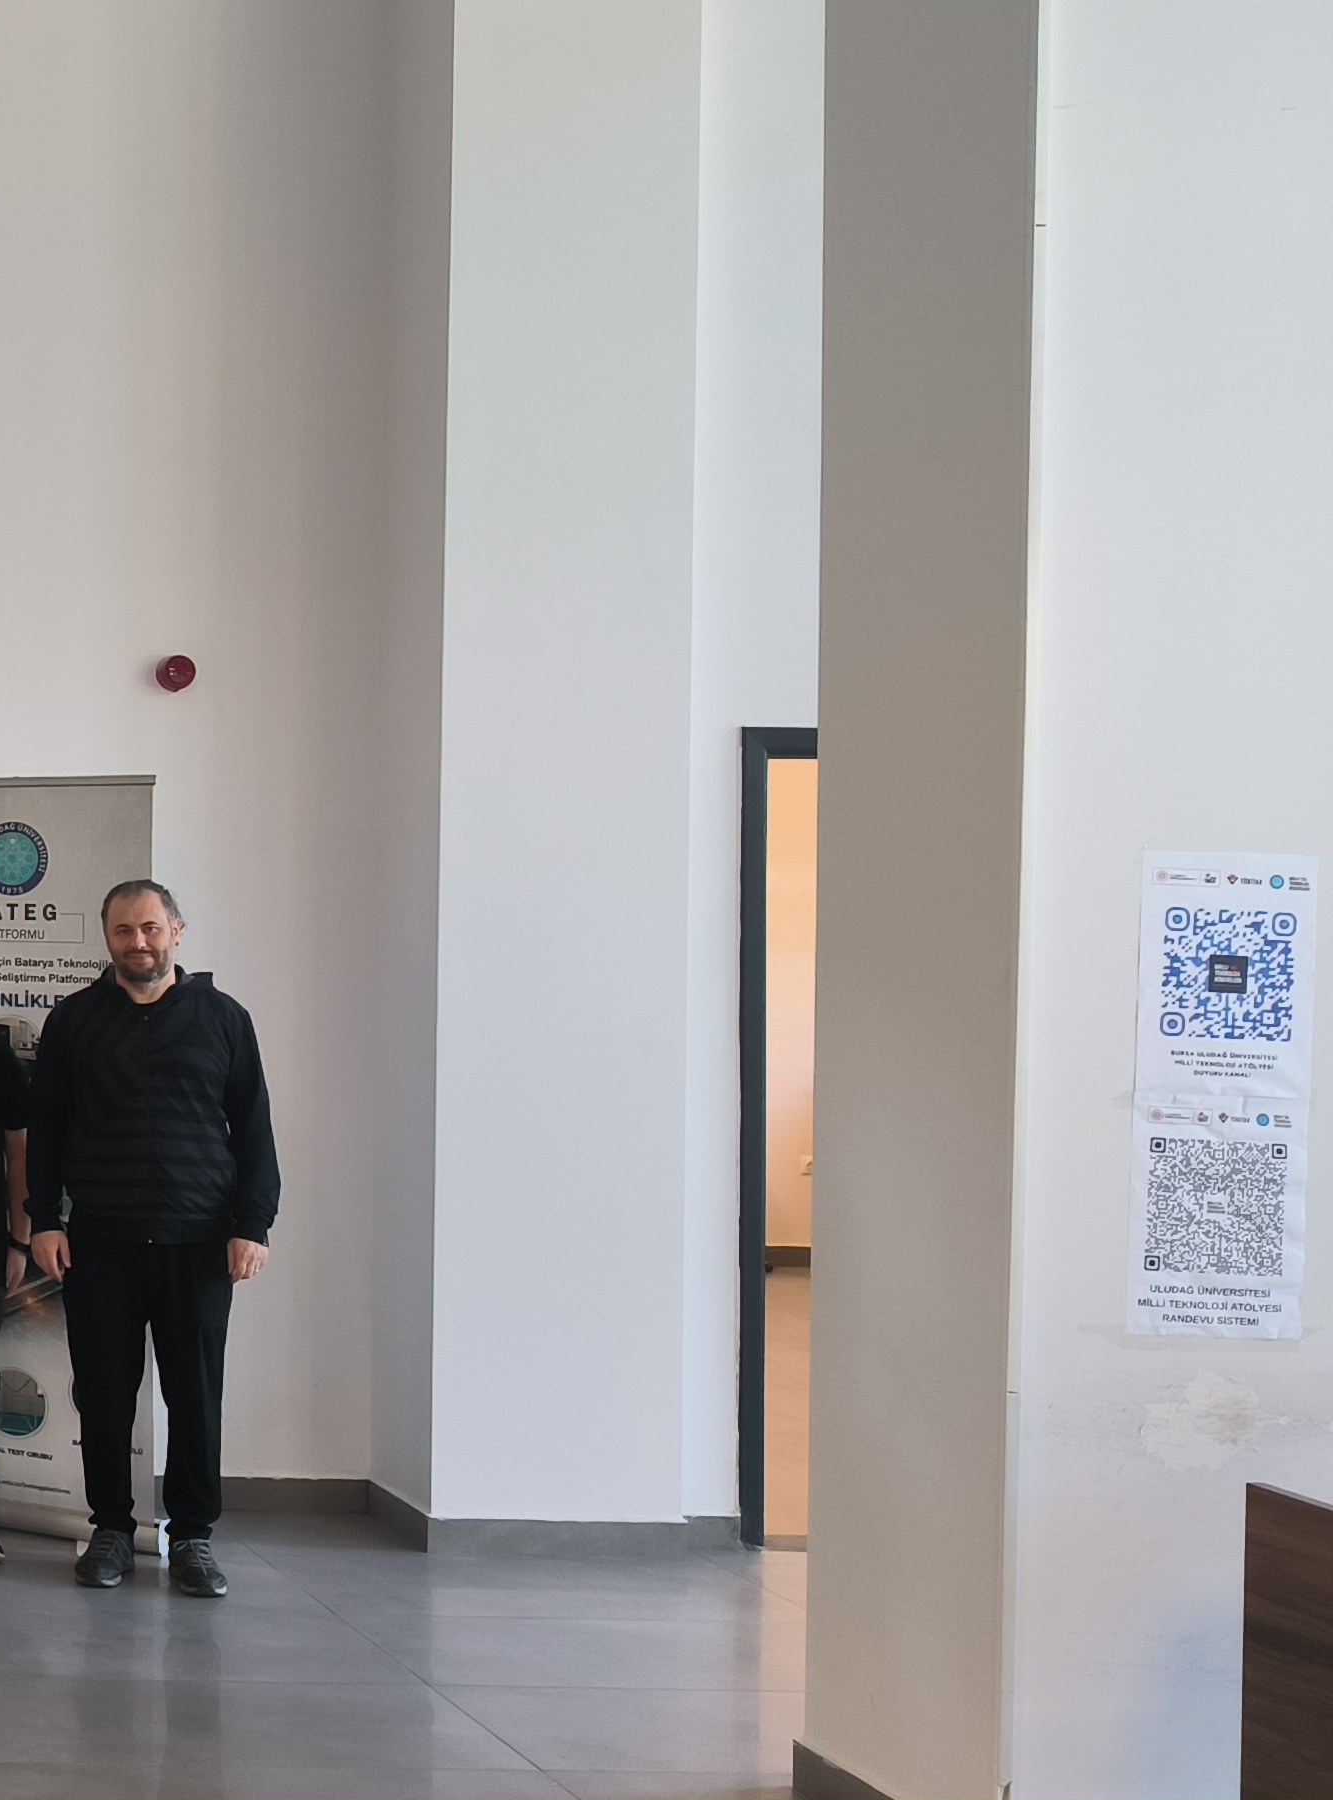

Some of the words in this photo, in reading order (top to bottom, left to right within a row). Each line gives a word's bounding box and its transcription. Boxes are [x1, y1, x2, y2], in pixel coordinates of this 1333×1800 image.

[15, 957, 54, 969] Batarya
[1149, 1284, 1194, 1295] ULUDAĞ
[1197, 1285, 1271, 1298] ÜNİVERSİTESİ
[1137, 1297, 1165, 1307] MİLLİ
[1168, 1300, 1228, 1310] TEKNOLOJİ
[1162, 1314, 1214, 1325] RANDEVU
[7, 1448, 25, 1456] TEST
